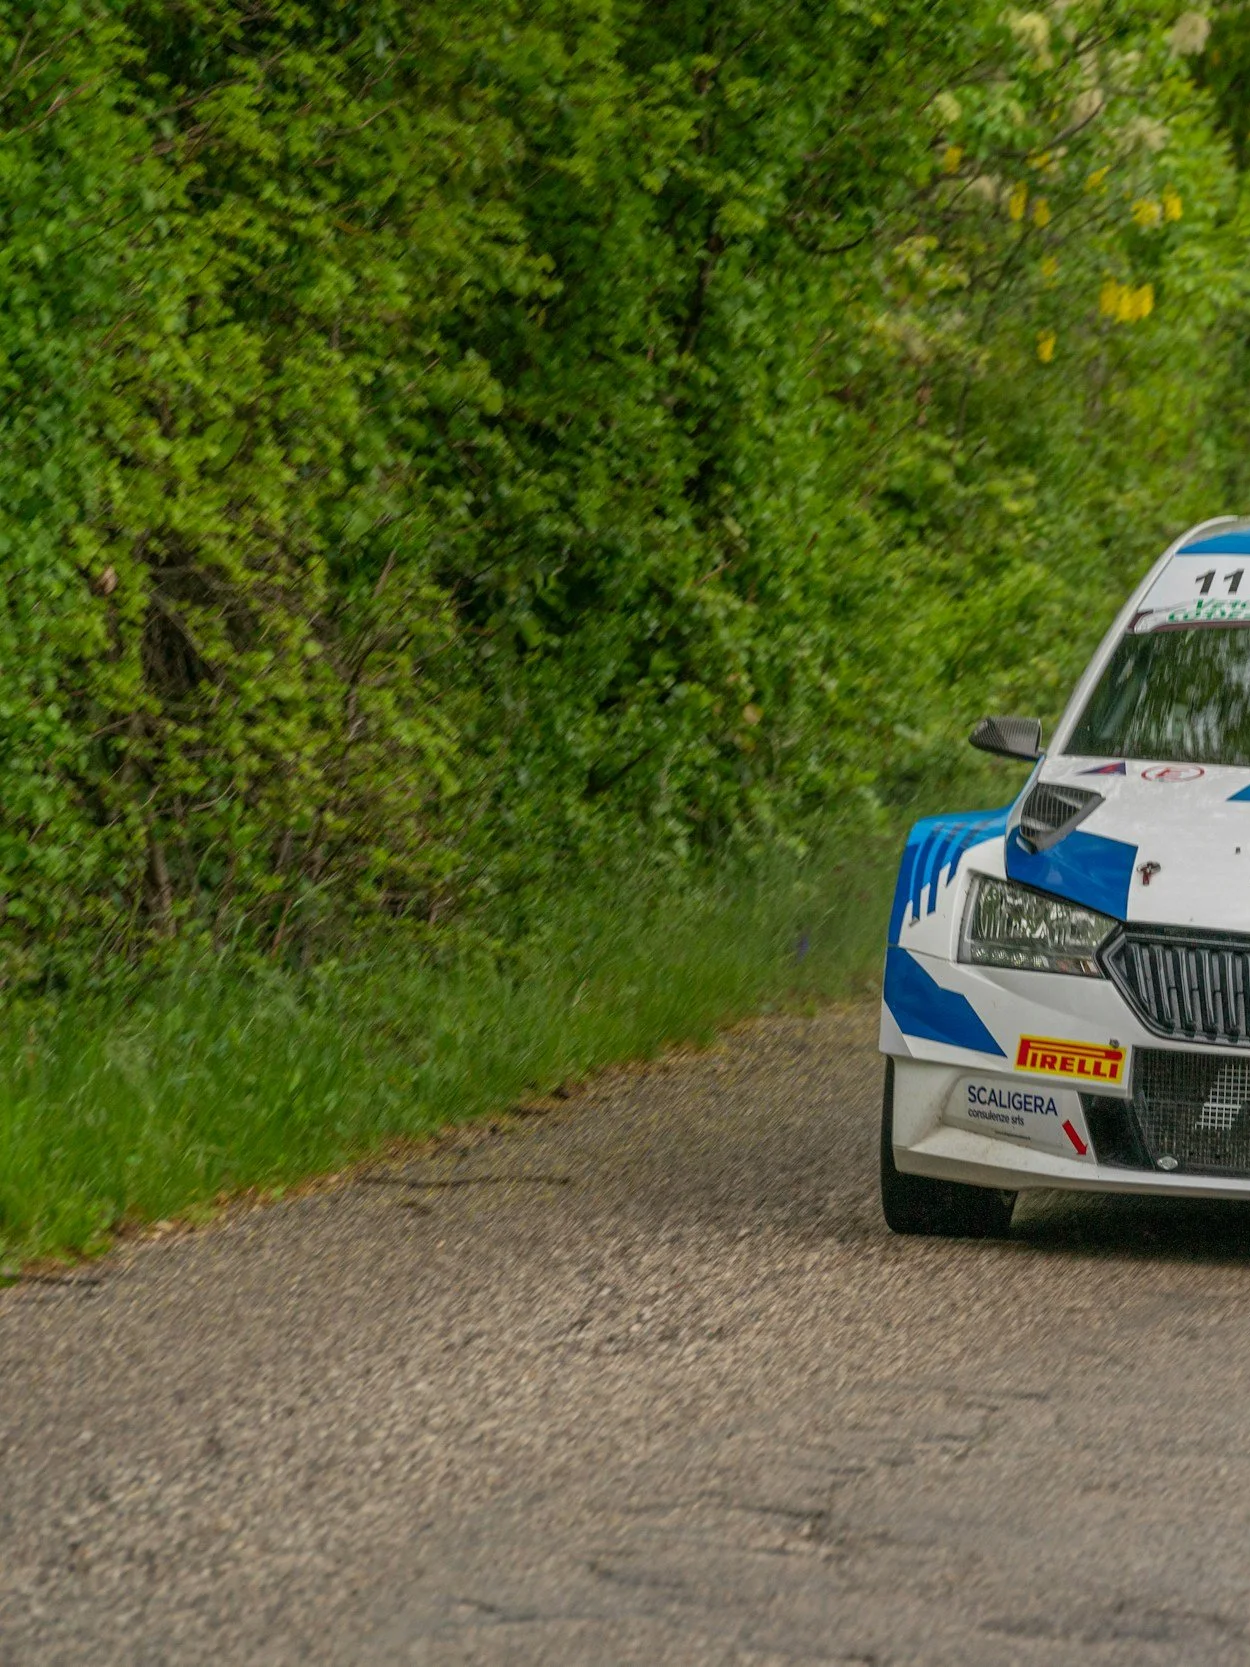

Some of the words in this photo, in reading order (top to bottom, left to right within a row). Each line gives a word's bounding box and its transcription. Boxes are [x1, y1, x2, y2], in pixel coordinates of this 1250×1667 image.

[1194, 567, 1246, 596] 11
[1016, 1038, 1123, 1079] PIRELLI
[967, 1084, 1059, 1117] SCALIGERA
[967, 1108, 1010, 1125] consulenze
